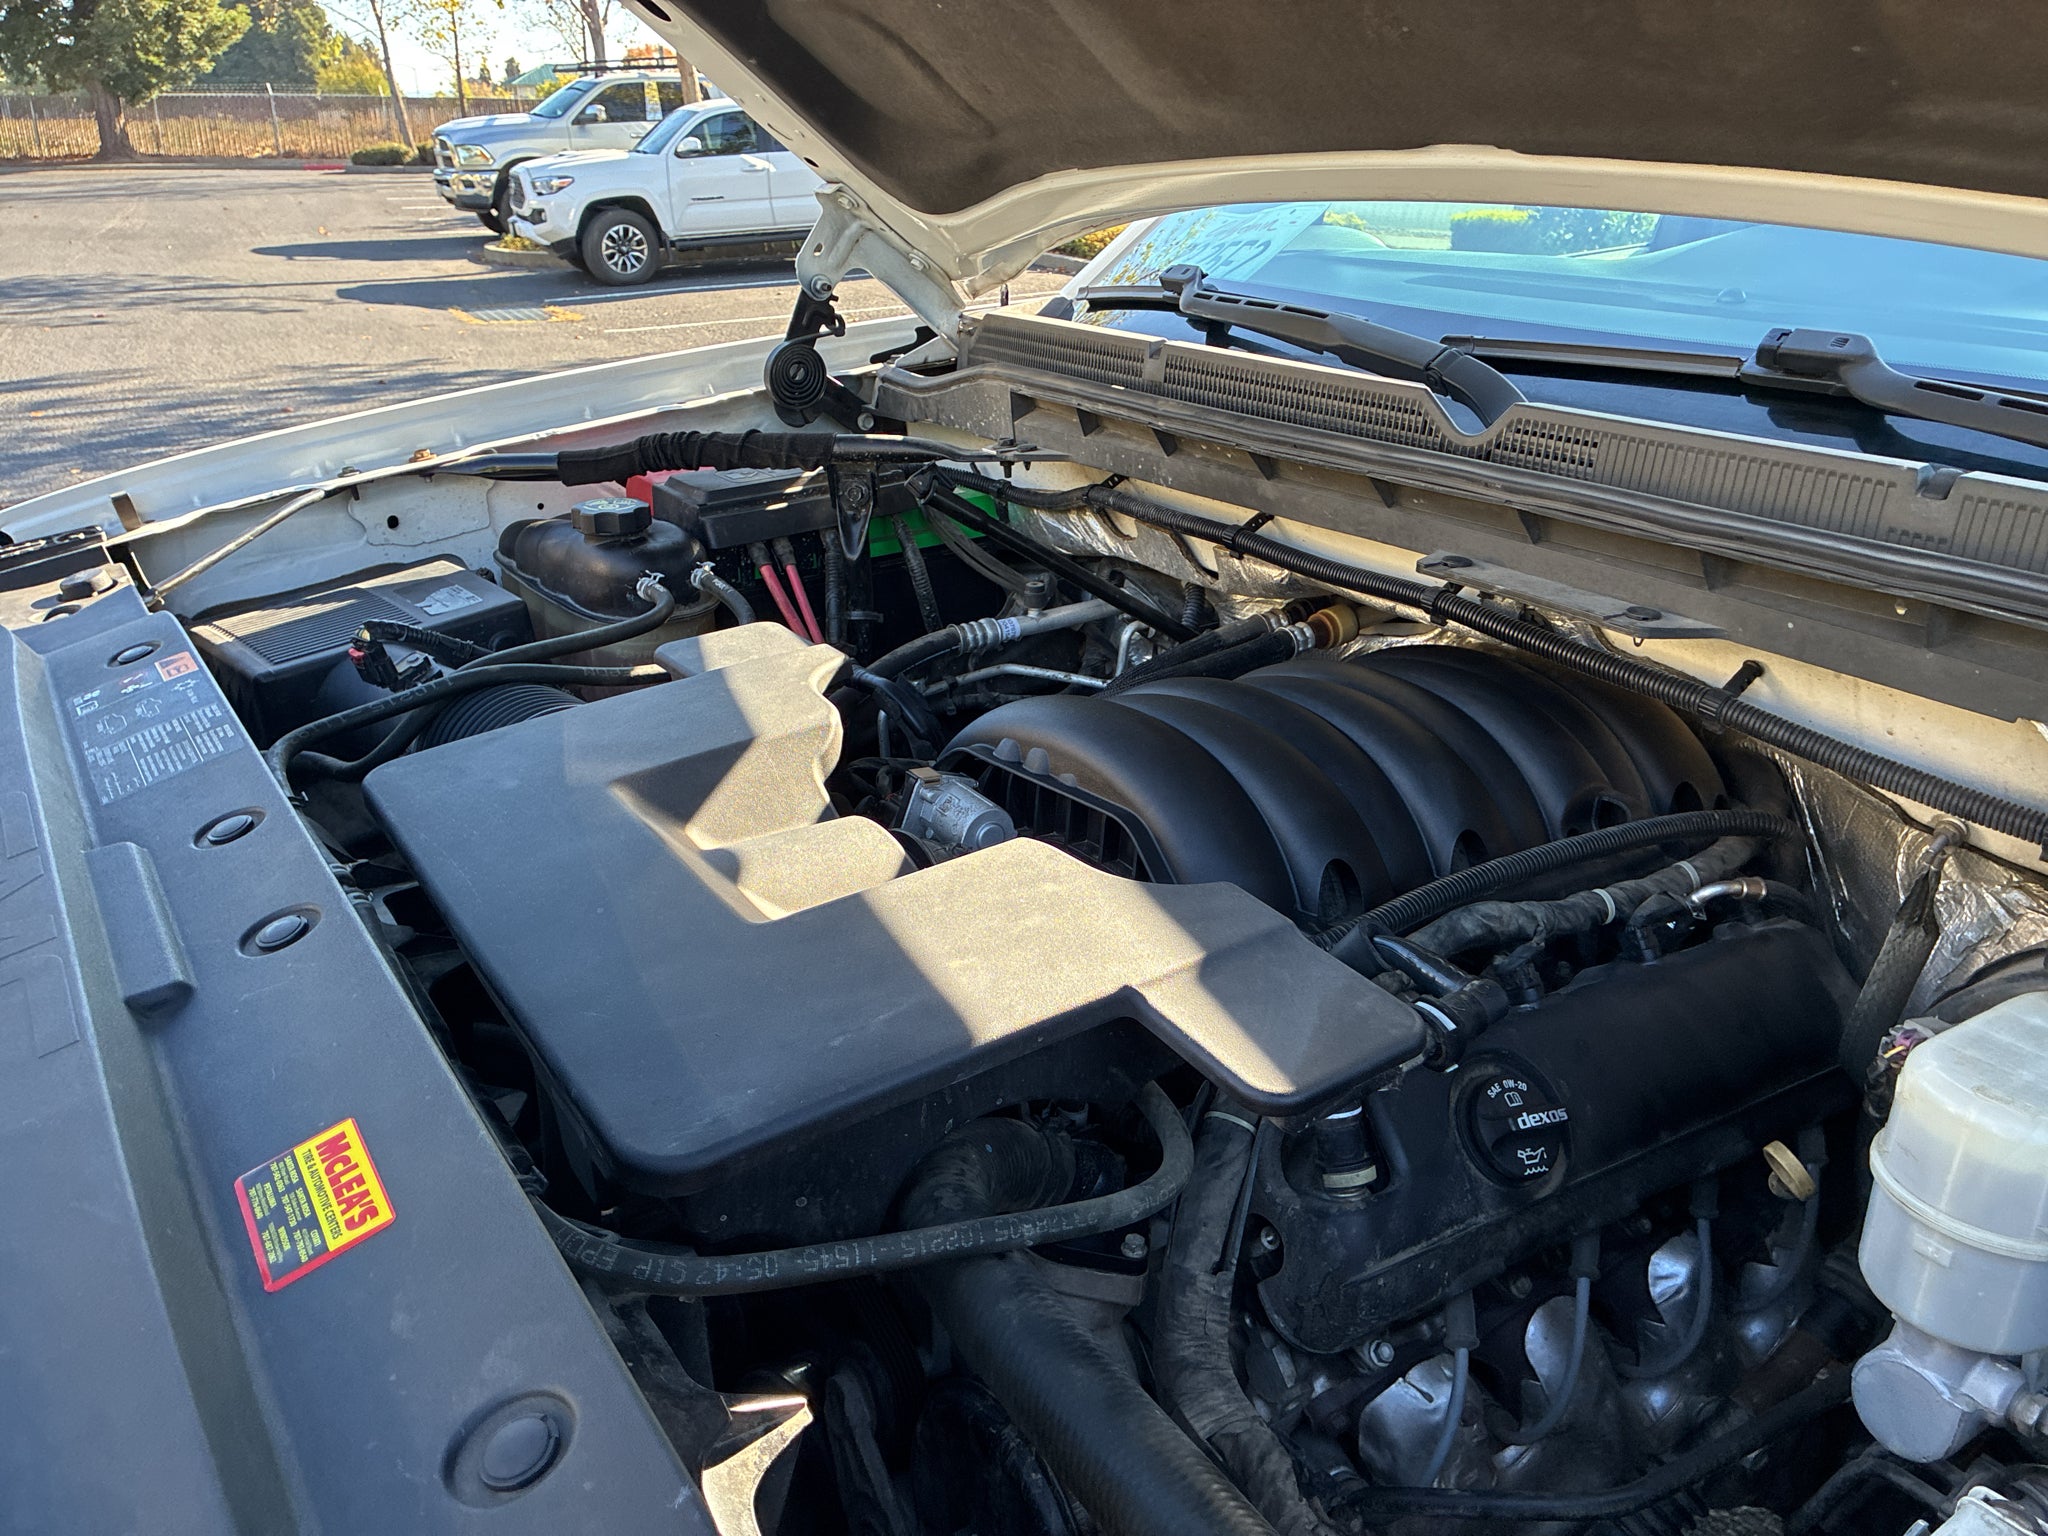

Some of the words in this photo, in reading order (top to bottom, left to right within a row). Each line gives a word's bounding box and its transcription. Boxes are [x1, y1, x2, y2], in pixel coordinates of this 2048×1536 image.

[1487, 1083, 1502, 1098] SAE
[1502, 1079, 1528, 1092] 0W-20
[1517, 1107, 1569, 1130] dexos
[302, 1148, 314, 1165] TIRE
[308, 1168, 331, 1211] AUTOMOTIVE
[324, 1209, 342, 1240] CENTERS
